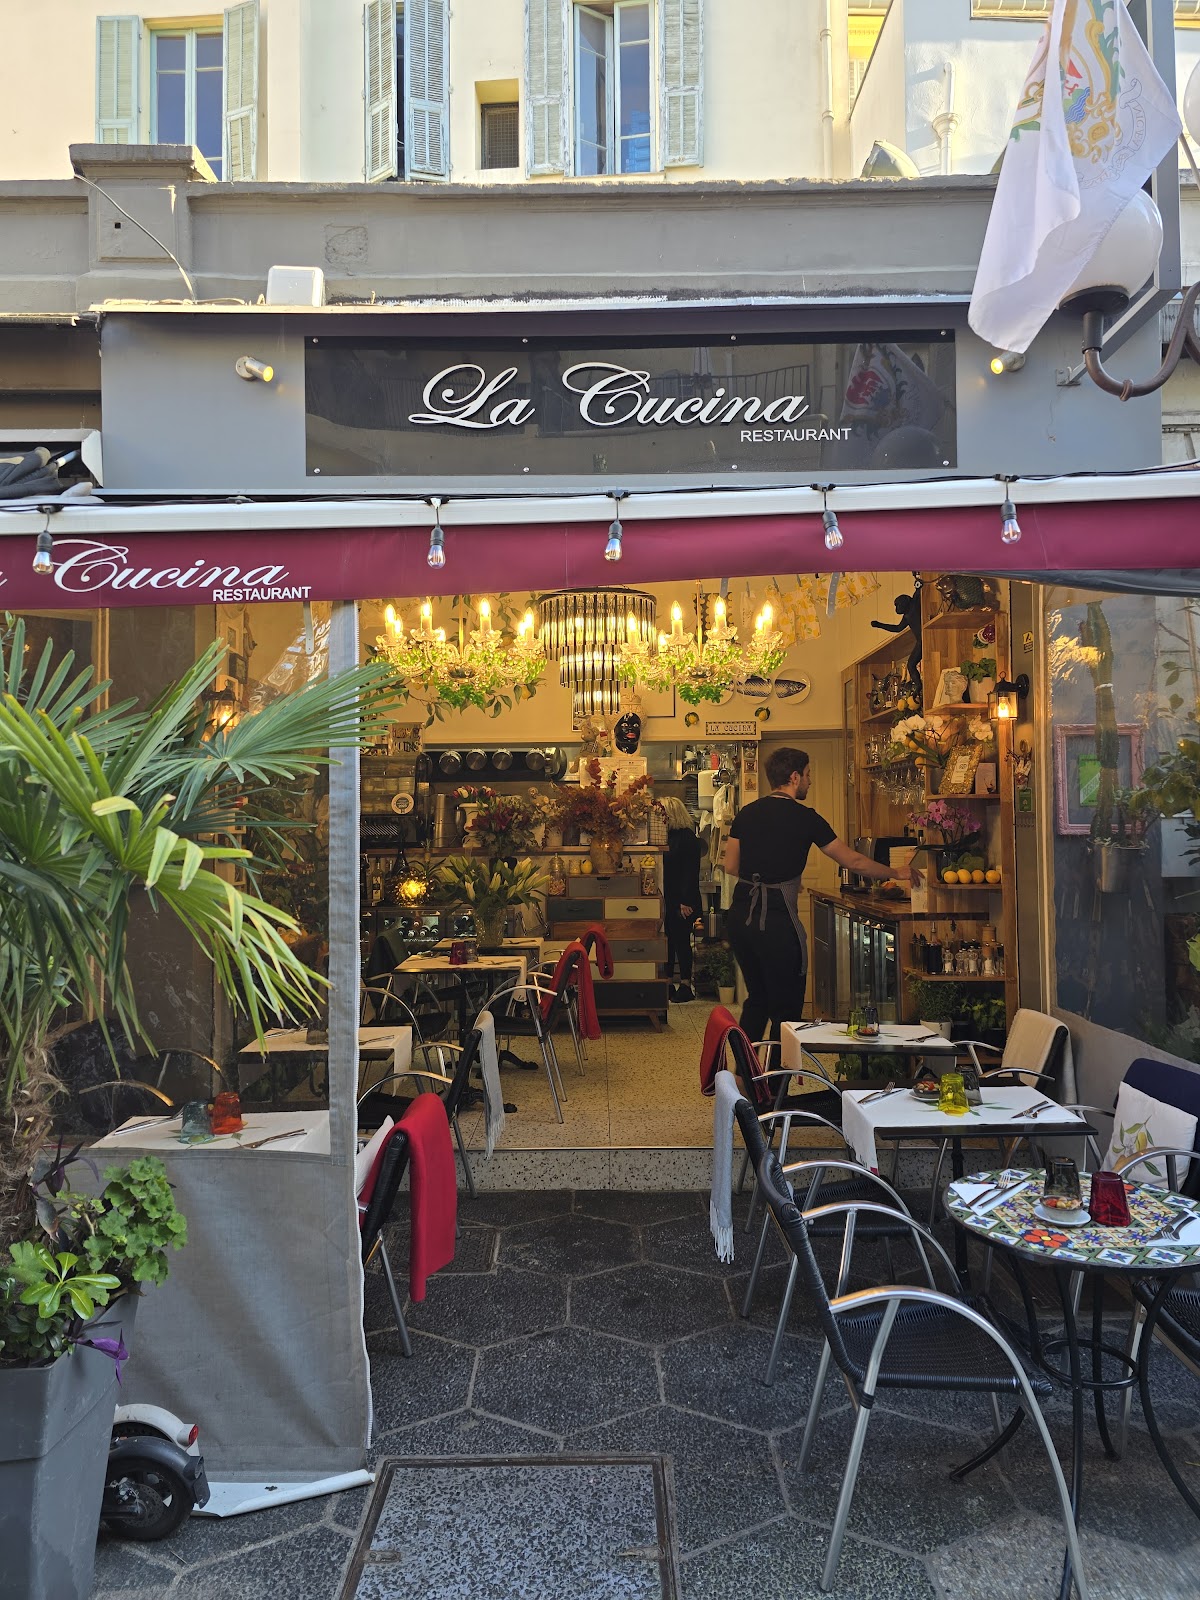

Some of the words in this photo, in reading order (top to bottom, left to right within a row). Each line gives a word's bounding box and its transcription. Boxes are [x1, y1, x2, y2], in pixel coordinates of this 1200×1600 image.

[408, 363, 537, 429] La
[562, 361, 810, 427] Cucina
[740, 427, 852, 443] RESTAURANT
[50, 539, 290, 593] Cucina
[212, 585, 312, 602] RESTAURANT
